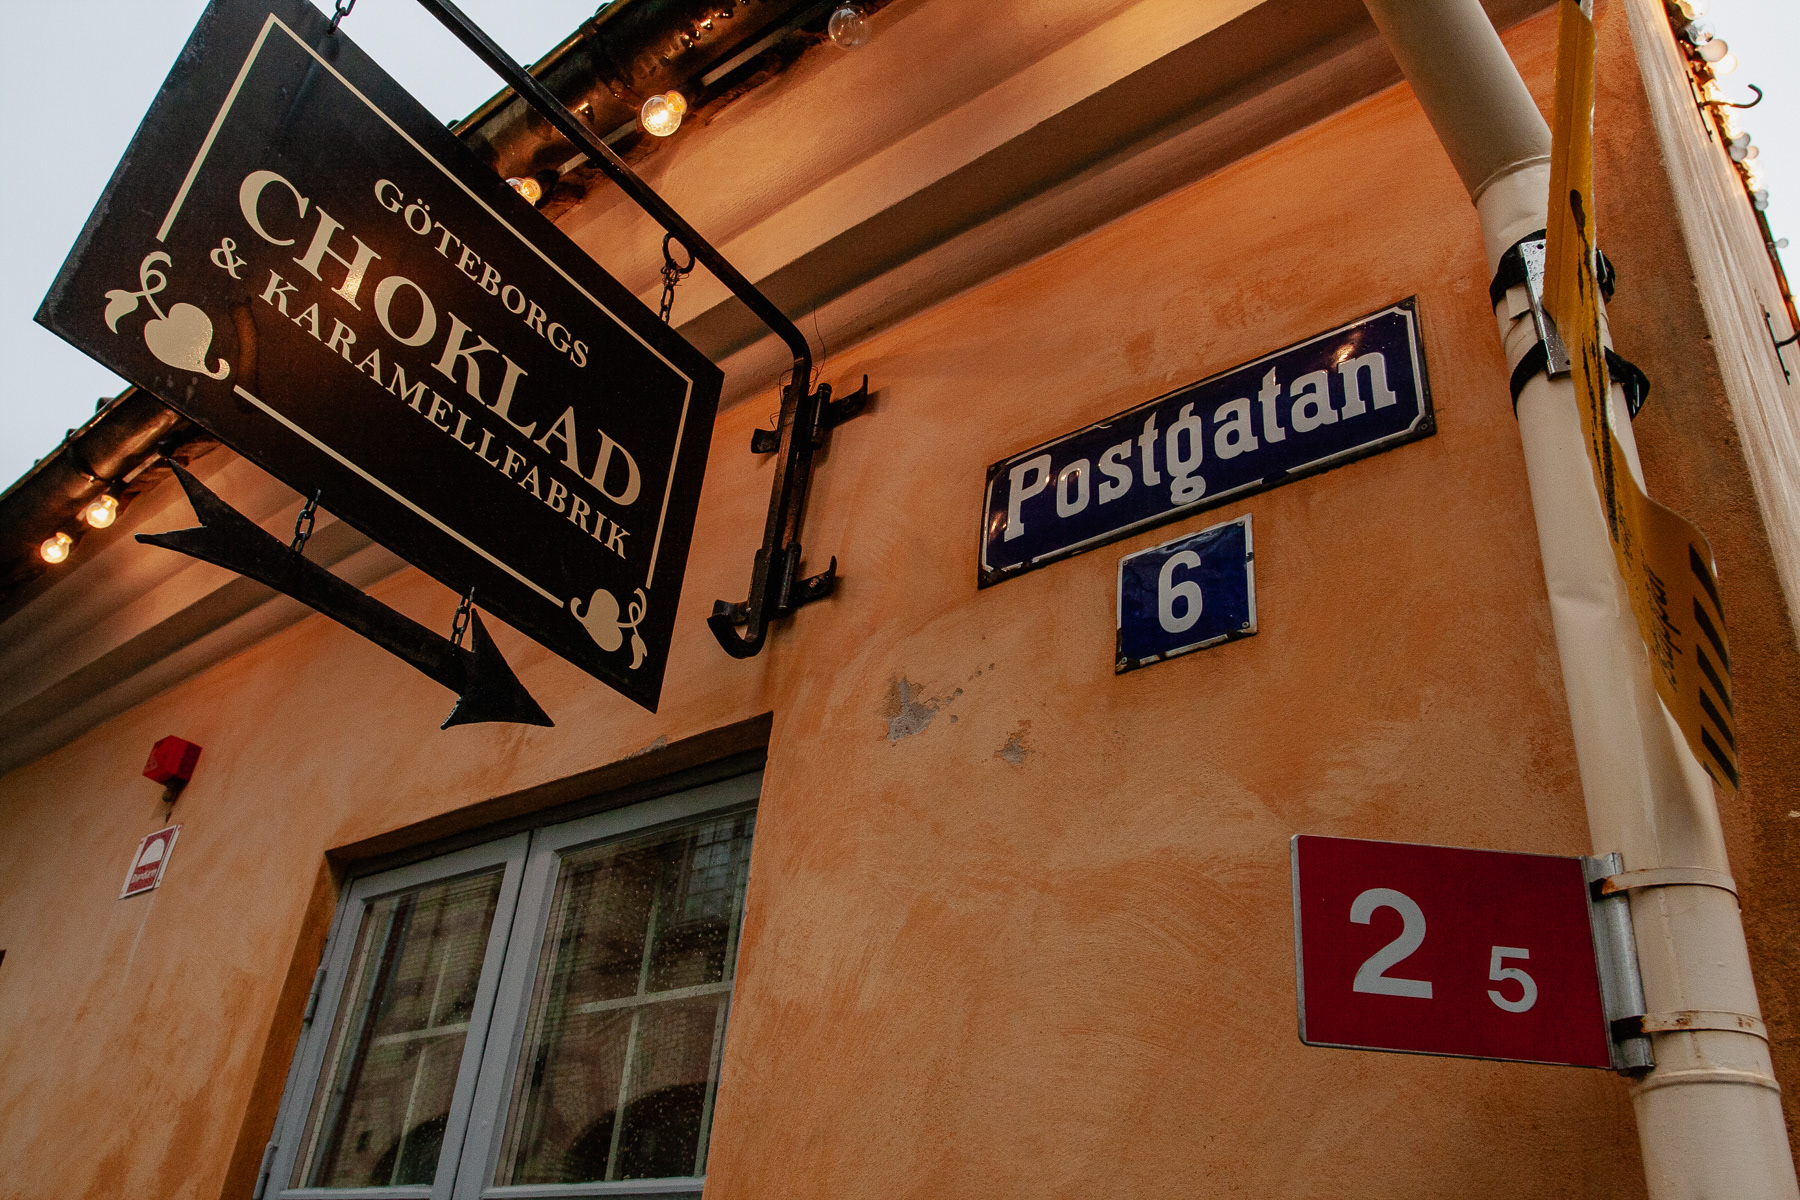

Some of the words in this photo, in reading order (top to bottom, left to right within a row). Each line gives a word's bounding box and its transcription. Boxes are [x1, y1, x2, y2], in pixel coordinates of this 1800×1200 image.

[238, 170, 642, 506] CHOKLAD
[373, 178, 589, 369] GÖTEBORGS
[210, 237, 247, 280] &
[258, 268, 632, 559] KARAMELLFABRIK
[1003, 350, 1397, 542] Postgatan
[1157, 550, 1203, 634] 6
[1349, 887, 1433, 999] 2
[1486, 945, 1538, 1013] 5
